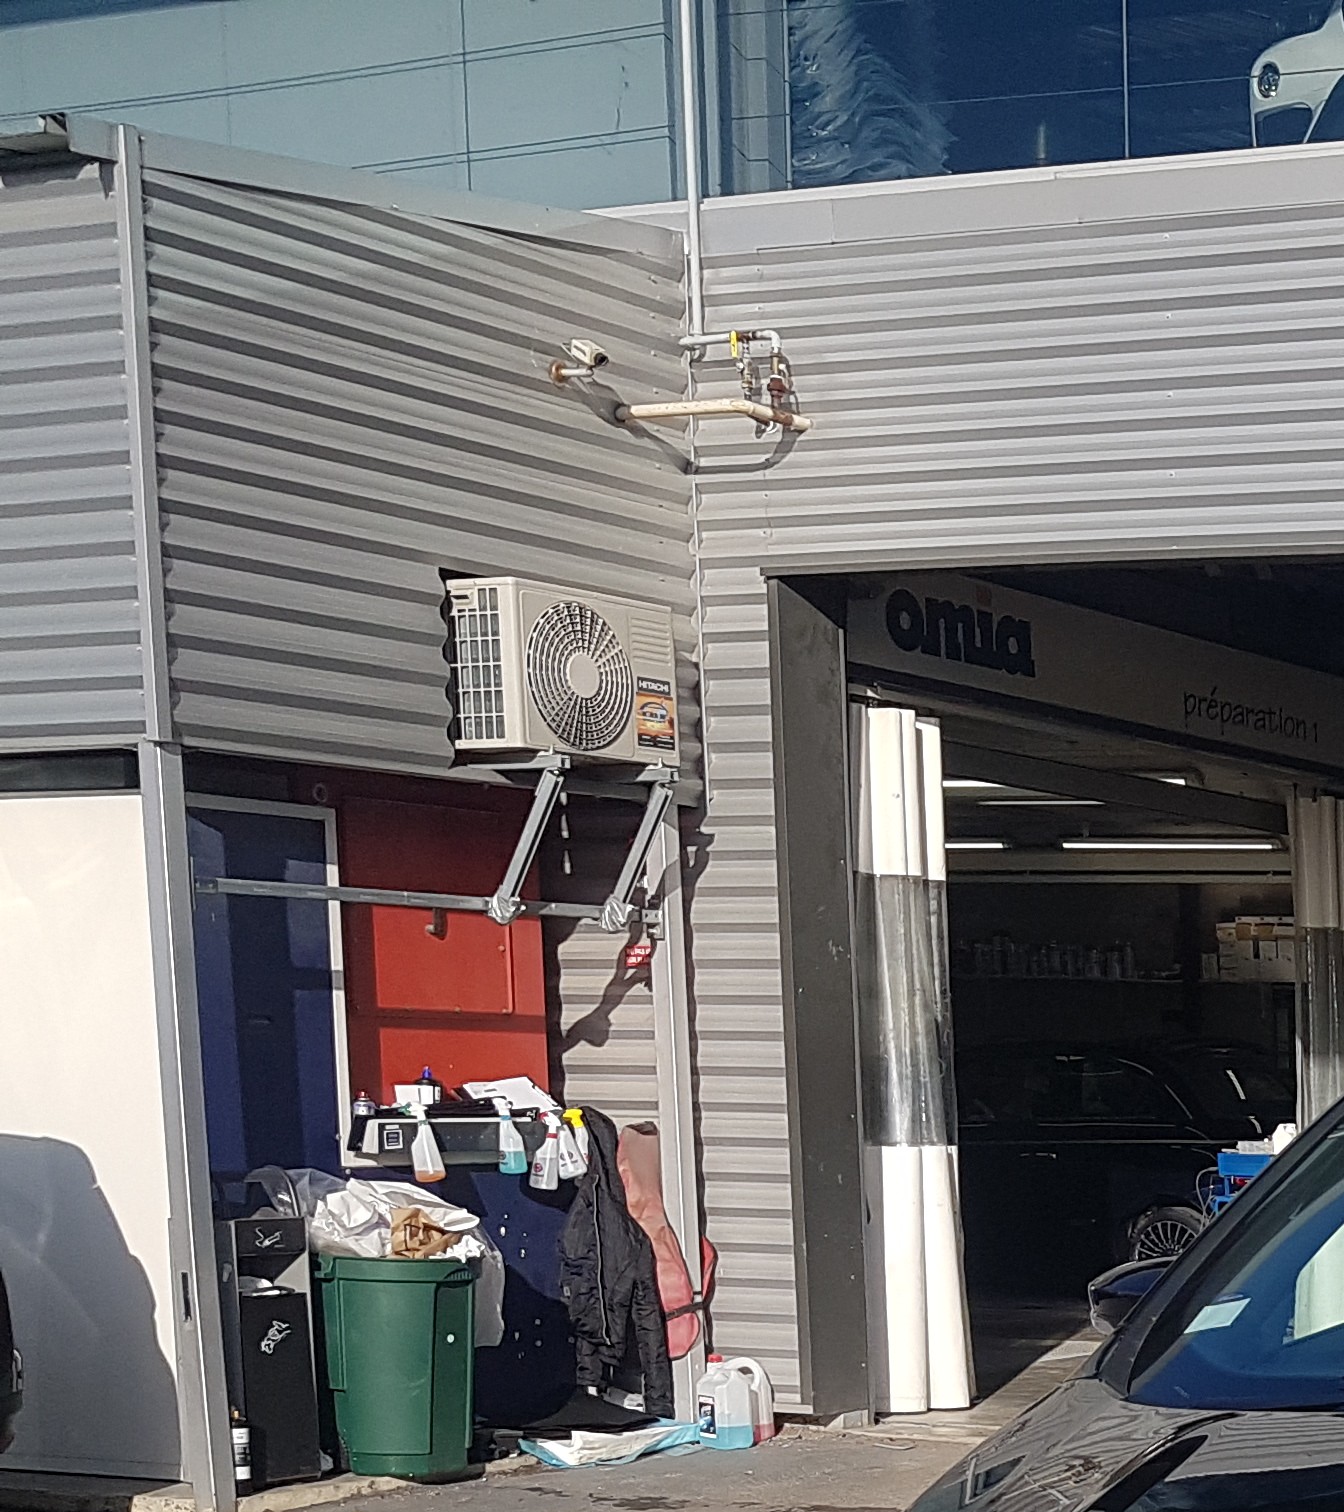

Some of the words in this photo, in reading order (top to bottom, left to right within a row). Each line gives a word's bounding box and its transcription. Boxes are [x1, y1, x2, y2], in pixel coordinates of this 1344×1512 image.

[885, 584, 1036, 678] omia
[638, 679, 670, 693] HITACHI
[1184, 686, 1307, 736] préparation
